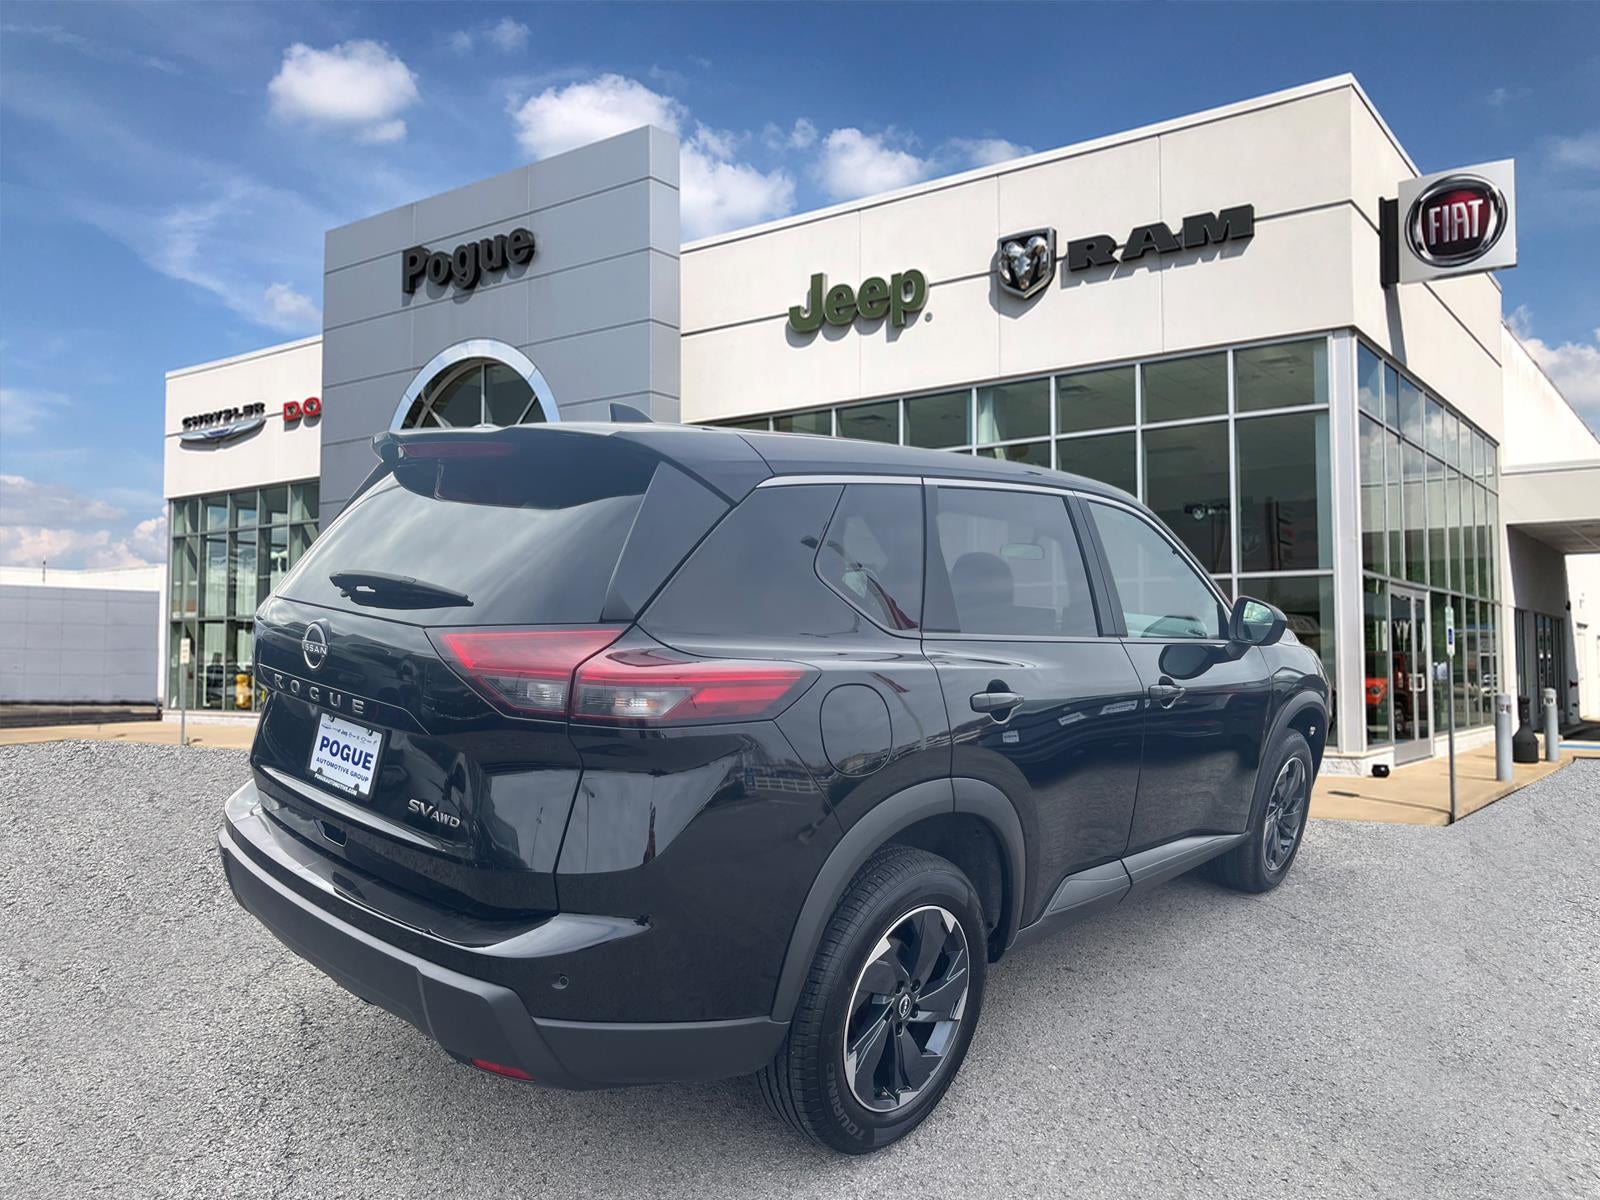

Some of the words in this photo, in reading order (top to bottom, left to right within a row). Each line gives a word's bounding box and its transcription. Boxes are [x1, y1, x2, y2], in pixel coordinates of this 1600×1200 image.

[1066, 203, 1255, 272] RAM
[1427, 199, 1484, 246] FIAT
[401, 228, 536, 294] Pogue
[788, 268, 929, 332] Jeep
[274, 673, 365, 714] ROGUE
[315, 756, 350, 774] AUTOMOTIVE
[349, 770, 369, 783] GROUP
[319, 735, 374, 771] POGUE
